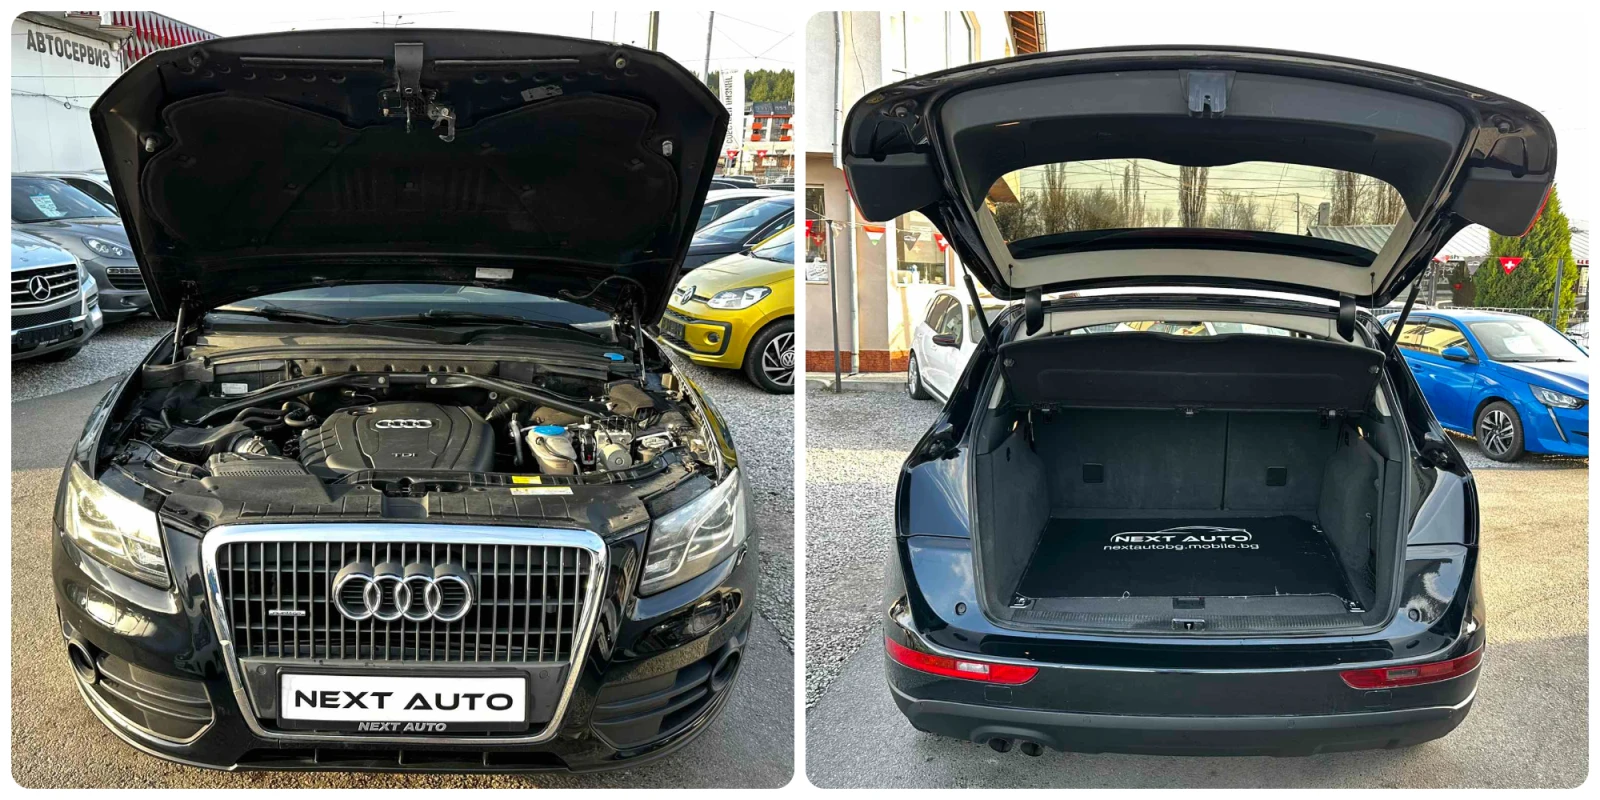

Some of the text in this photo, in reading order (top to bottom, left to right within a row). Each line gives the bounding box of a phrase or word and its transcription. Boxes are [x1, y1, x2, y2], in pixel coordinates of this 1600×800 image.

[26, 29, 110, 69] АВТОСЕРВИЗ
[295, 690, 514, 711] NEXT AUTO
[358, 721, 447, 732] NEXT AUTO
